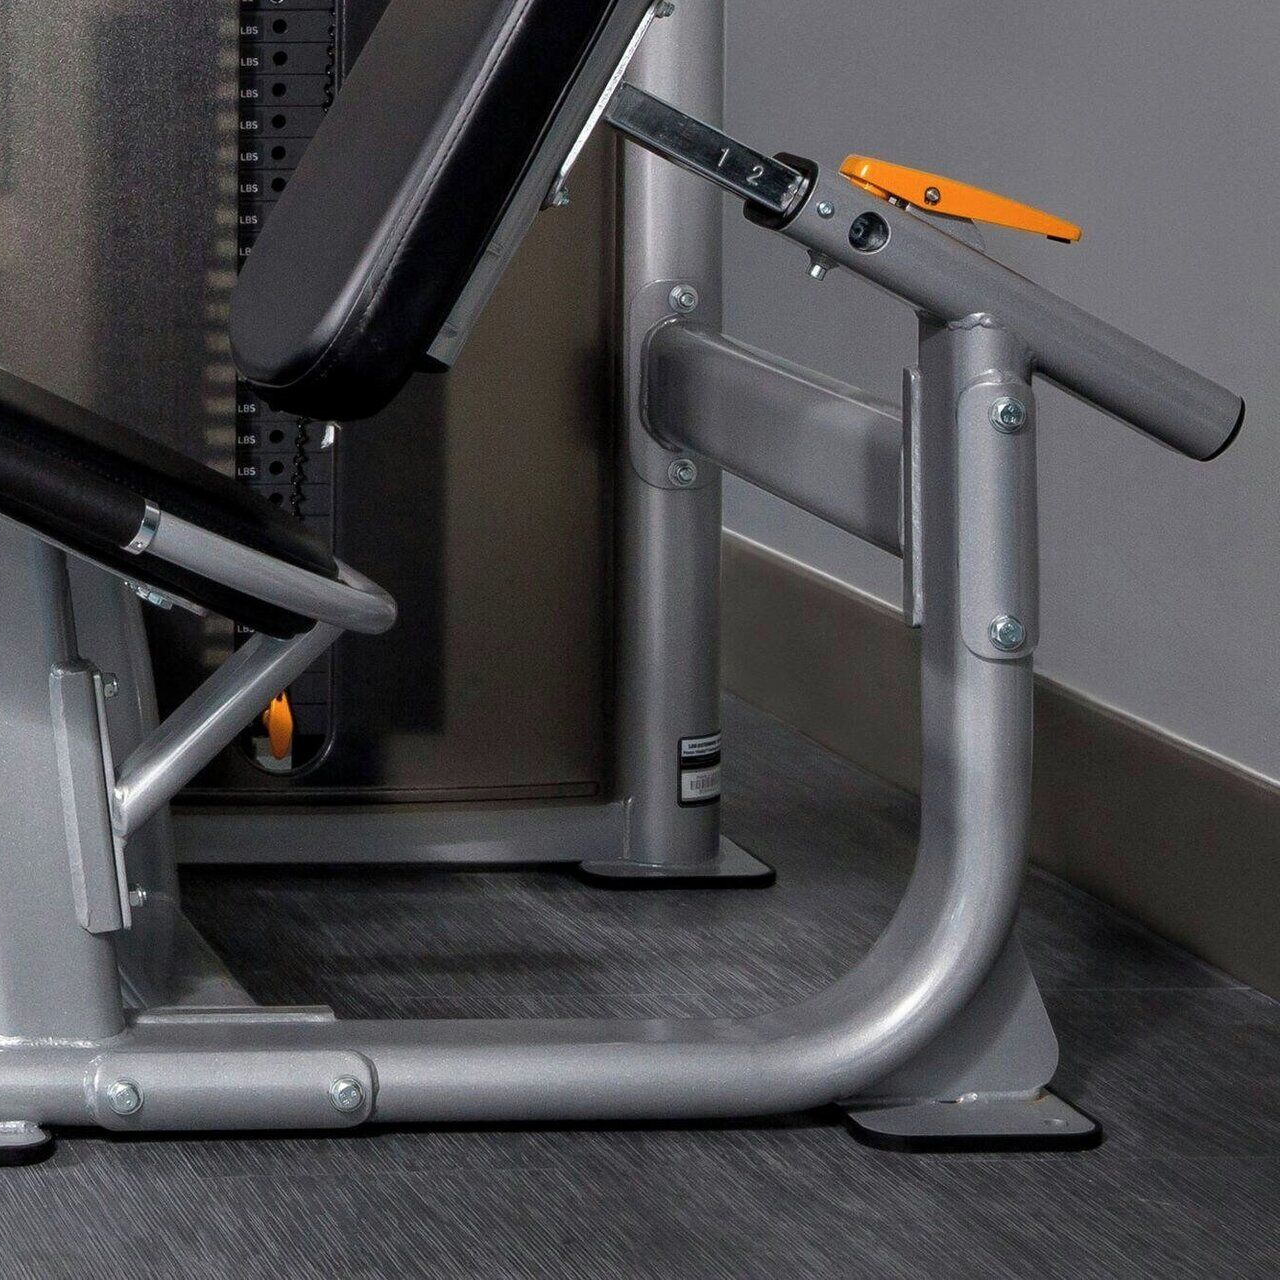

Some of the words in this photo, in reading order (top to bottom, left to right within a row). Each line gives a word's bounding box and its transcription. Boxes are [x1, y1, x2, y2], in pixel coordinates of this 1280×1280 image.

[240, 26, 259, 35] LBS
[240, 58, 259, 67] LBS
[240, 89, 259, 98] LBS
[240, 120, 258, 129] LBS
[240, 152, 259, 161] LBS
[717, 148, 730, 167] 1
[746, 165, 764, 187] 2
[240, 184, 259, 193] LBS
[239, 215, 258, 224] LBS
[237, 404, 256, 413] LBS
[237, 435, 256, 444] LBS
[237, 467, 256, 476] LBS
